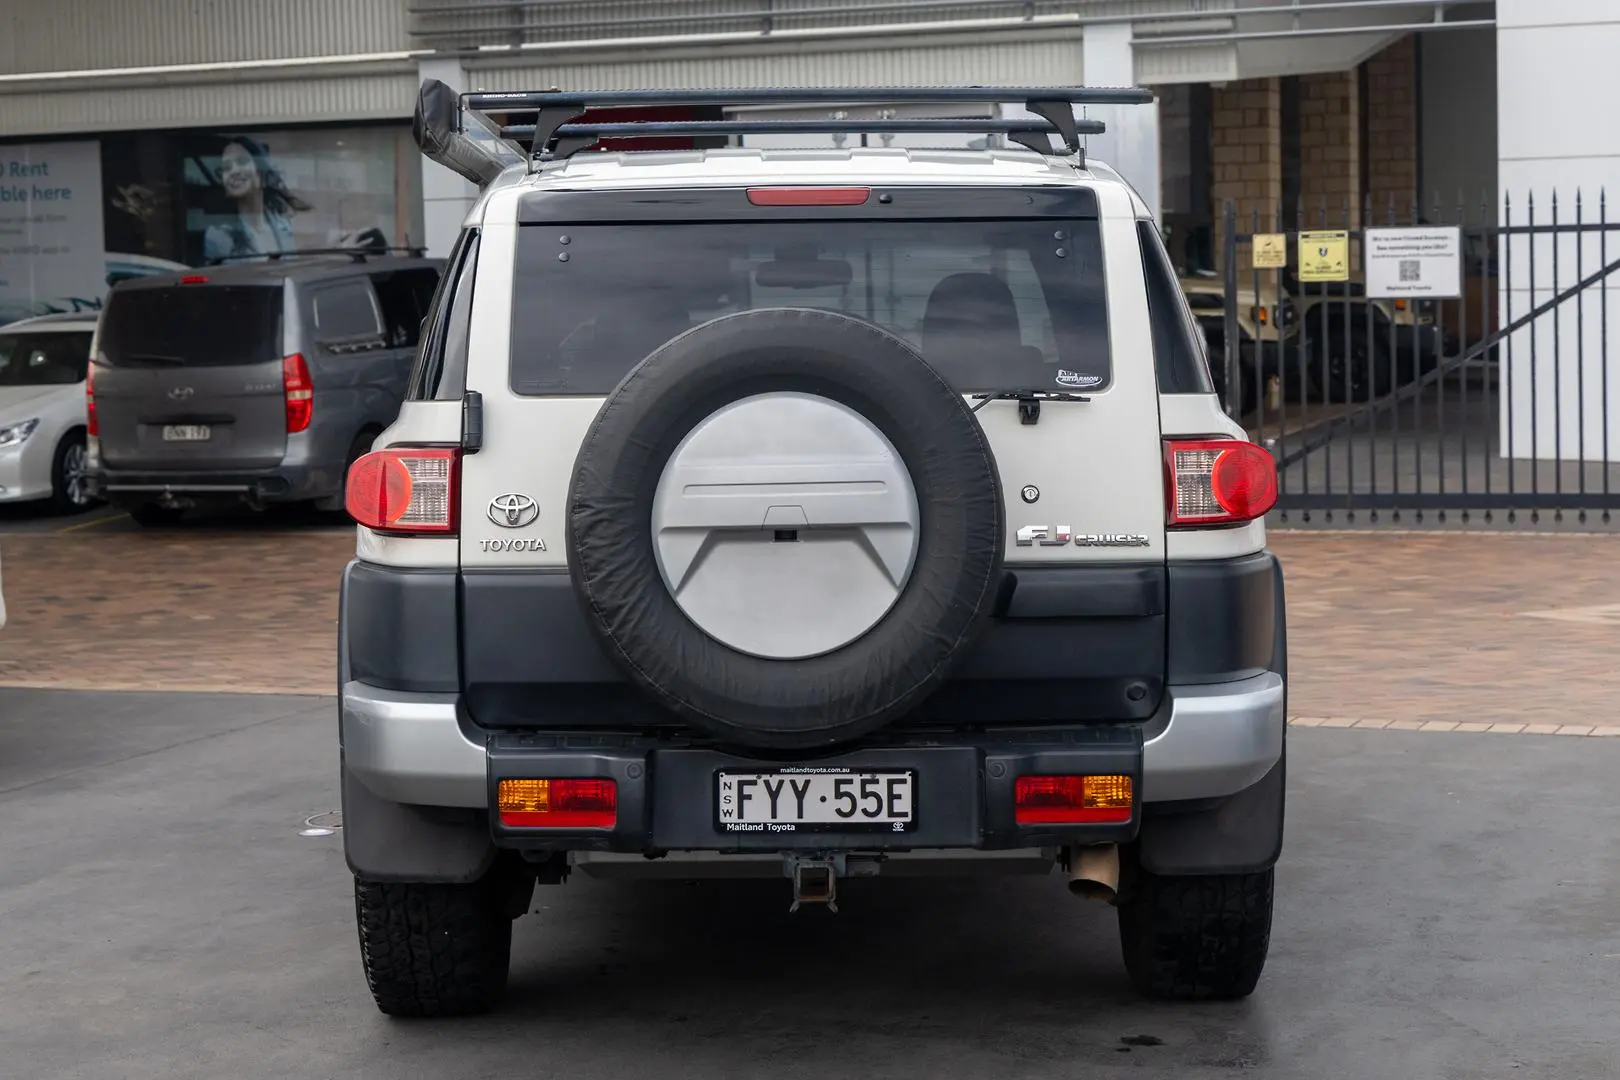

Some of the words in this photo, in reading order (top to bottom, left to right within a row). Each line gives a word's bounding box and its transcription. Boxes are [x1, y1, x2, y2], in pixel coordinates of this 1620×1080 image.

[9, 161, 49, 177] Rent
[32, 183, 72, 200] here
[1016, 525, 1070, 546] FJ
[1075, 534, 1150, 546] CRUISER
[480, 538, 546, 552] TOYOTA
[726, 823, 764, 831] Maitland
[767, 823, 796, 832] Toyota
